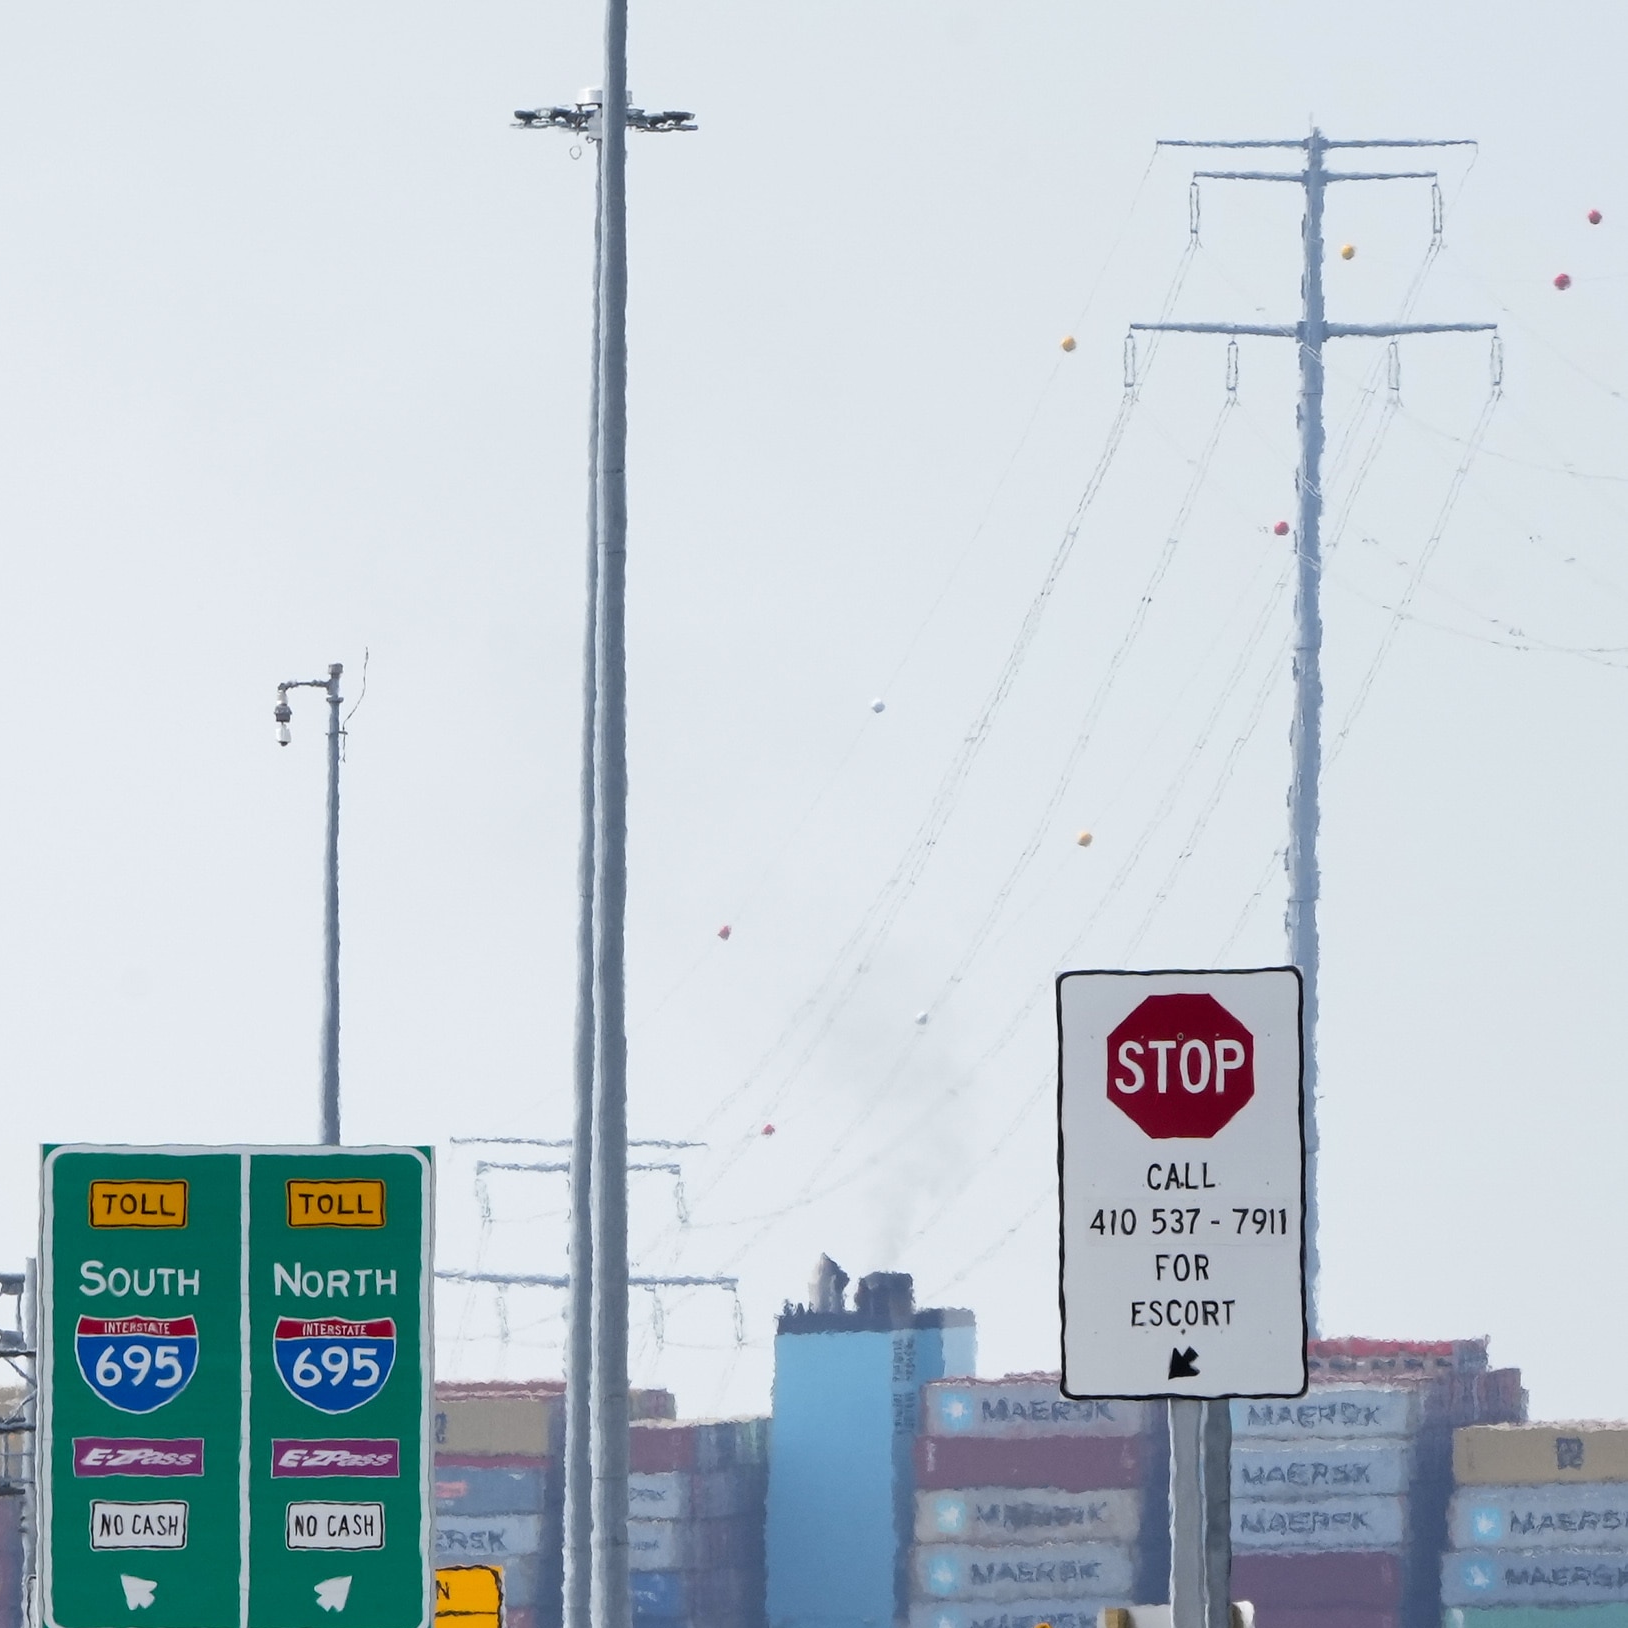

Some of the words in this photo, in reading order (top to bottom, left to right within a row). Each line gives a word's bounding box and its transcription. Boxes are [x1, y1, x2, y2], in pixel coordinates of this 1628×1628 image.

[1115, 1039, 1245, 1094] STOP
[1147, 1163, 1215, 1190] CALL
[102, 1193, 176, 1217] TOLL
[299, 1192, 374, 1215] TOLL
[1090, 1208, 1137, 1235] 410
[1151, 1208, 1201, 1235] 537
[1232, 1208, 1288, 1235] 7911
[79, 1260, 200, 1297] SOUTH
[274, 1262, 397, 1298] NORTH
[1156, 1254, 1209, 1281] FOR
[1131, 1300, 1235, 1327] ESCORT
[104, 1321, 171, 1335] INTERSTATE
[302, 1323, 367, 1336] INTERSTATE
[95, 1345, 182, 1387] 695
[293, 1346, 380, 1387] 695
[99, 1514, 124, 1537] NO
[132, 1514, 179, 1537] CASH
[294, 1514, 317, 1537] NO
[327, 1514, 374, 1537] CASH
[1510, 1510, 1628, 1535] MAERS
